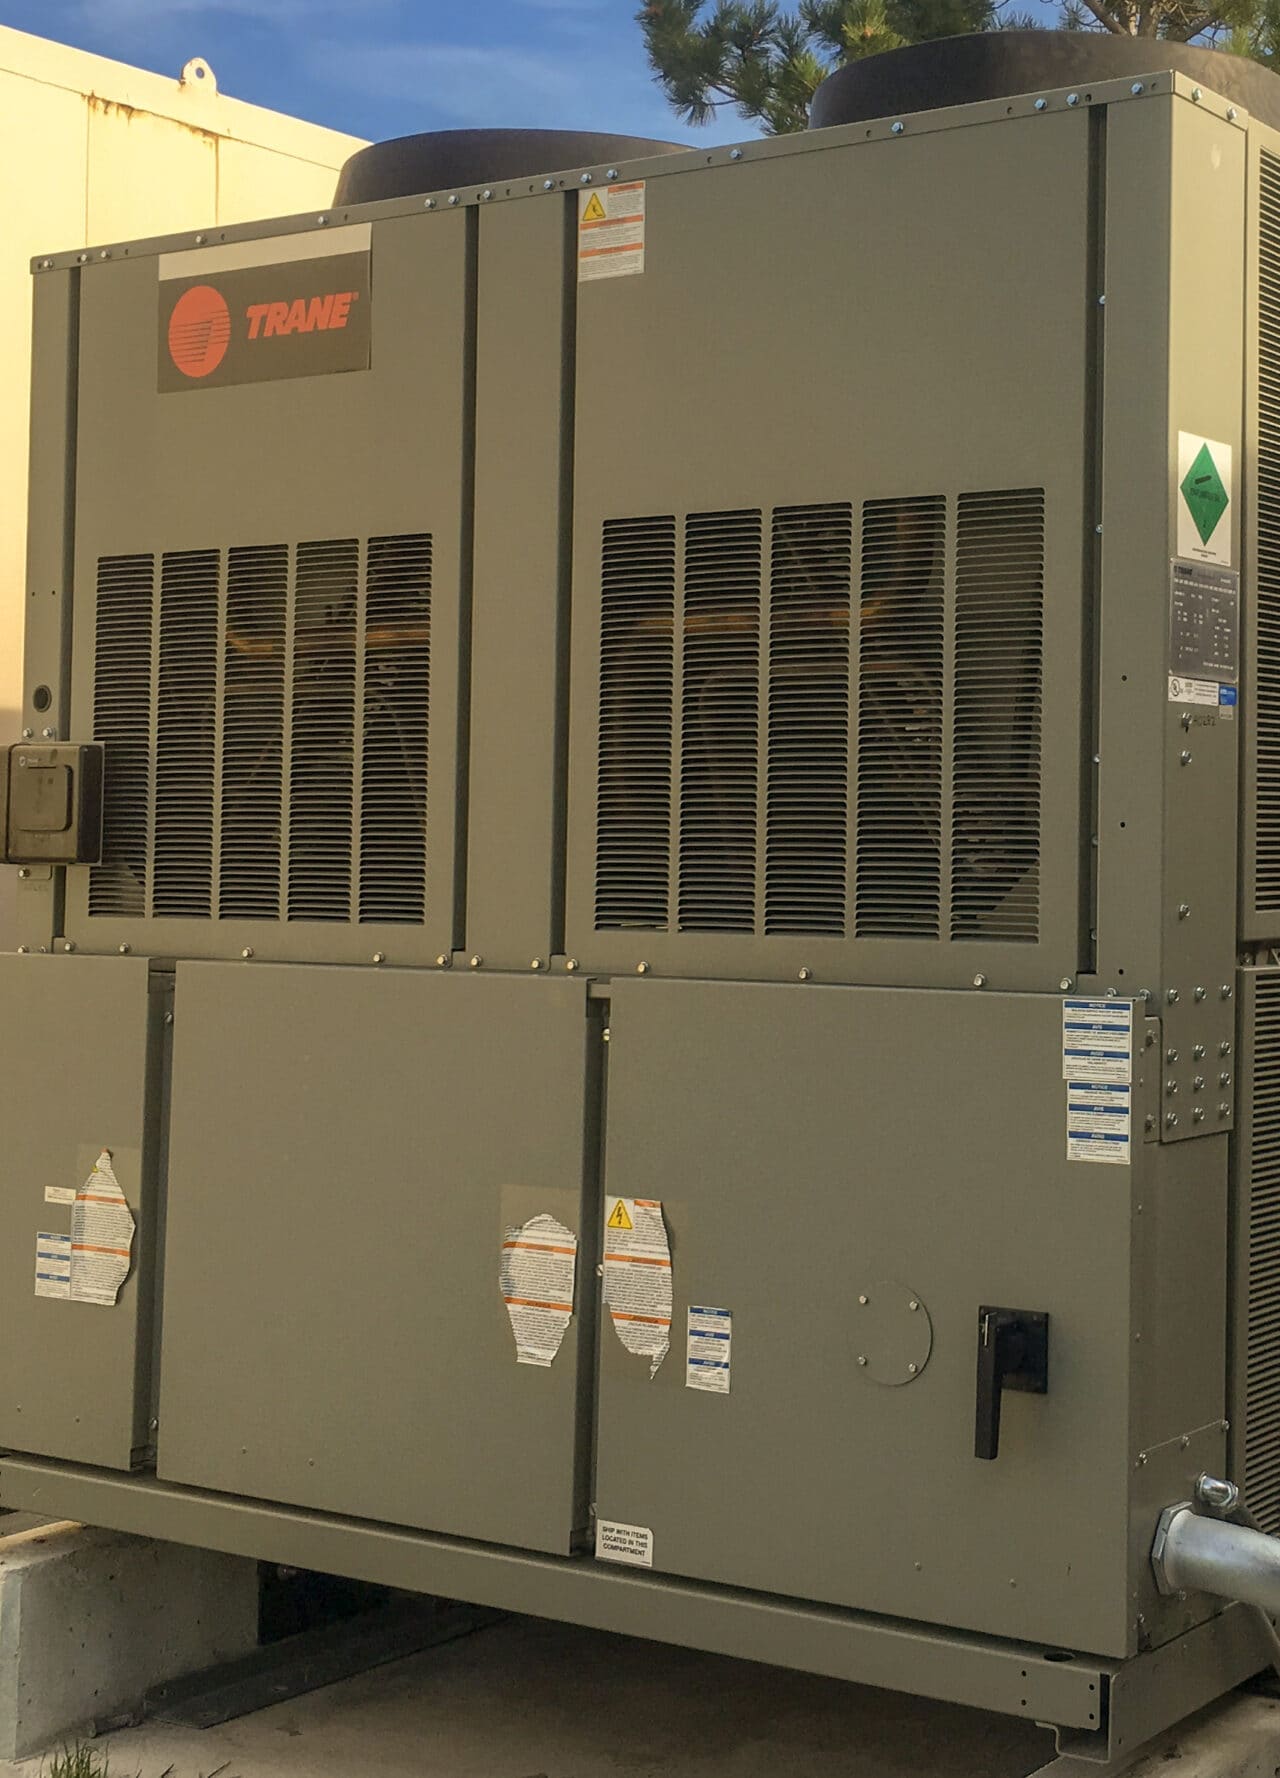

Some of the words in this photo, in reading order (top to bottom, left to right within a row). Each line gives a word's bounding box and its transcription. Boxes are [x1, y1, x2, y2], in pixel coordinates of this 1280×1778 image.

[247, 292, 353, 339] TRANE
[602, 1534, 627, 1545] LOCATED
[635, 1540, 648, 1548] THIS
[631, 1531, 648, 1540] ITEMS
[603, 1543, 645, 1556] COMPARTMENT
